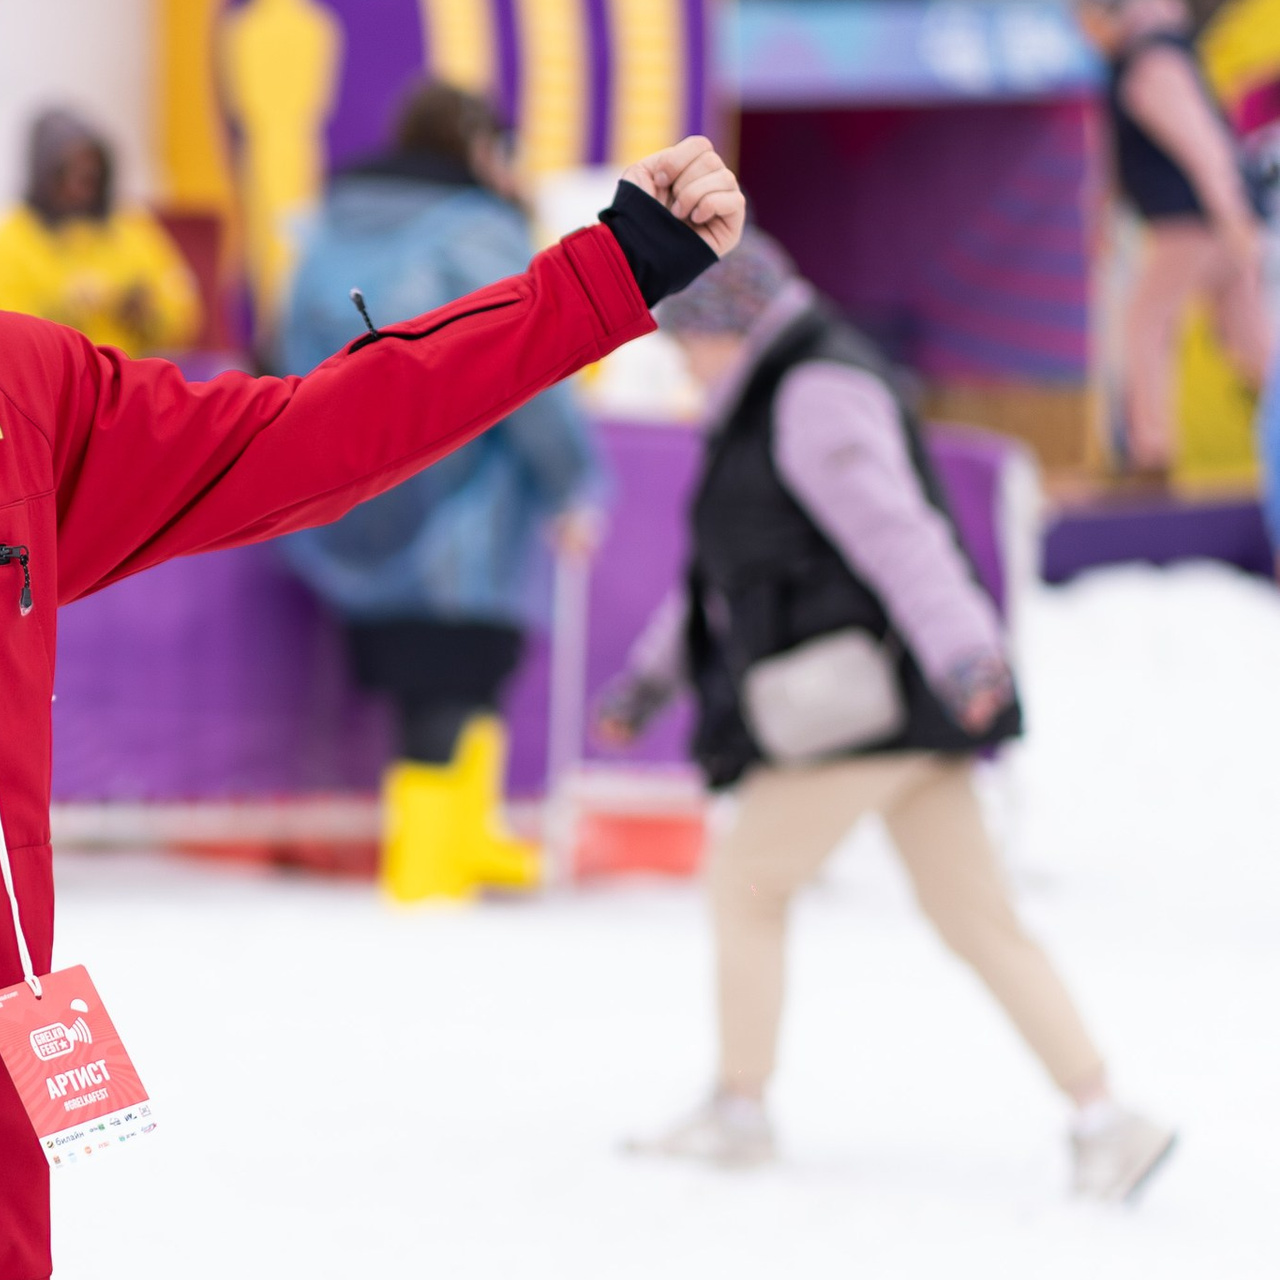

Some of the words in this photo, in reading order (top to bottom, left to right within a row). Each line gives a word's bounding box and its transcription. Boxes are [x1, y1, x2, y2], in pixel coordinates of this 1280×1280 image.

[34, 1026, 65, 1046] GRELKA
[39, 1041, 61, 1057] FEST
[46, 1059, 111, 1100] АРТИСТ
